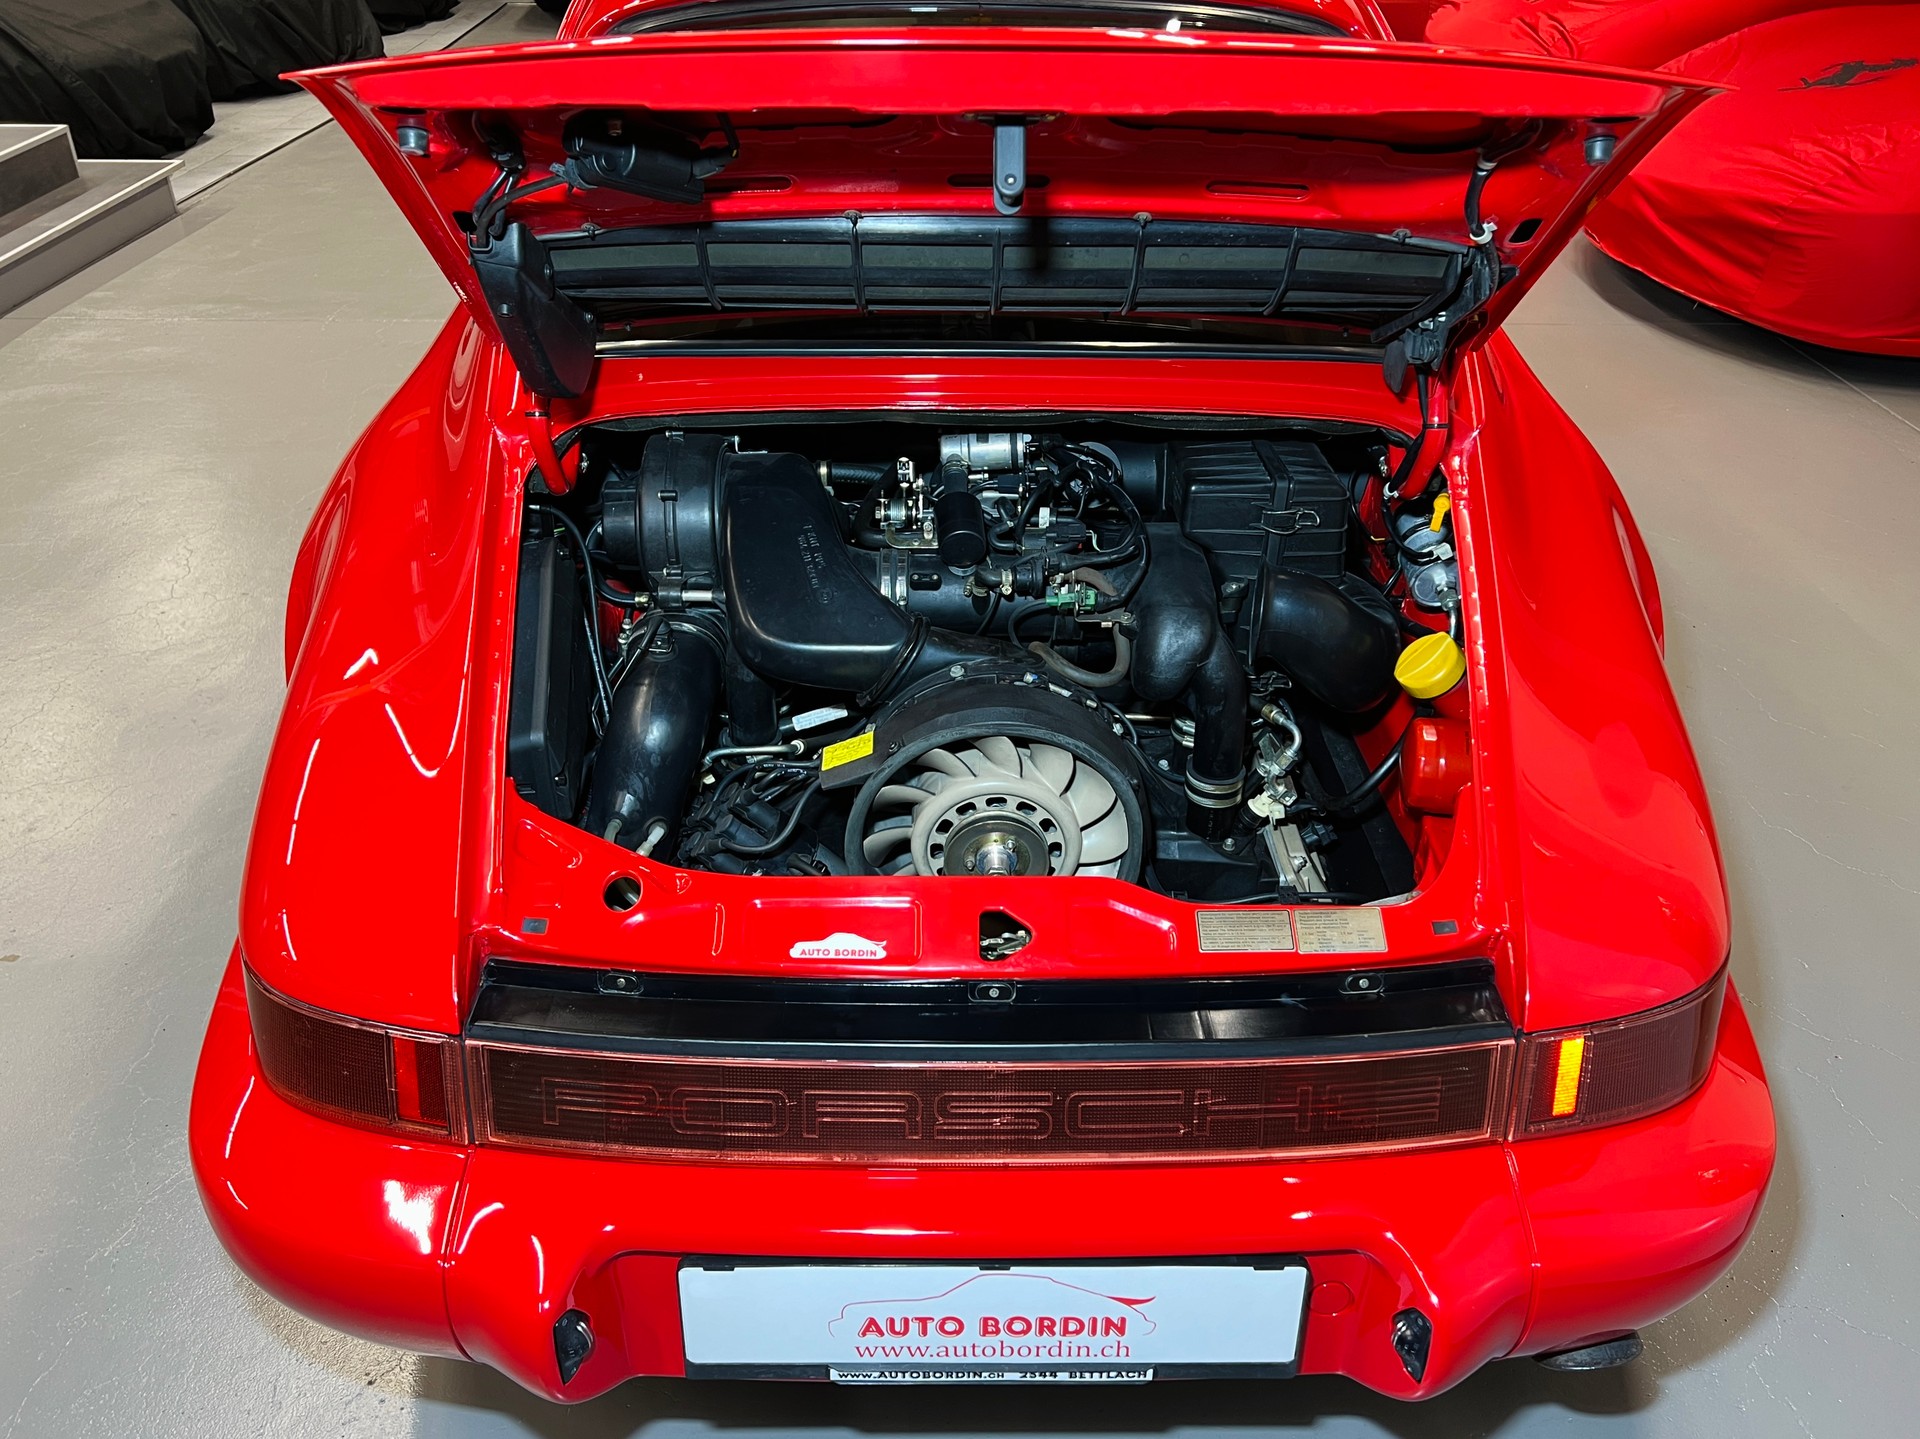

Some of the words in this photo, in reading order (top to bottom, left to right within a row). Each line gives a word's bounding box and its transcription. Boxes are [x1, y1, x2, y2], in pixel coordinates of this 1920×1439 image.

[800, 948, 831, 956] AUTO
[834, 948, 877, 957] BORDIN
[541, 1075, 1442, 1140] PORSCHE
[857, 1316, 965, 1338] AUTO
[979, 1316, 1127, 1338] BORDIN
[854, 1340, 1131, 1358] www.autobordin.ch
[1018, 1370, 1058, 1380] 2544
[1068, 1370, 1148, 1380] BETTLACH
